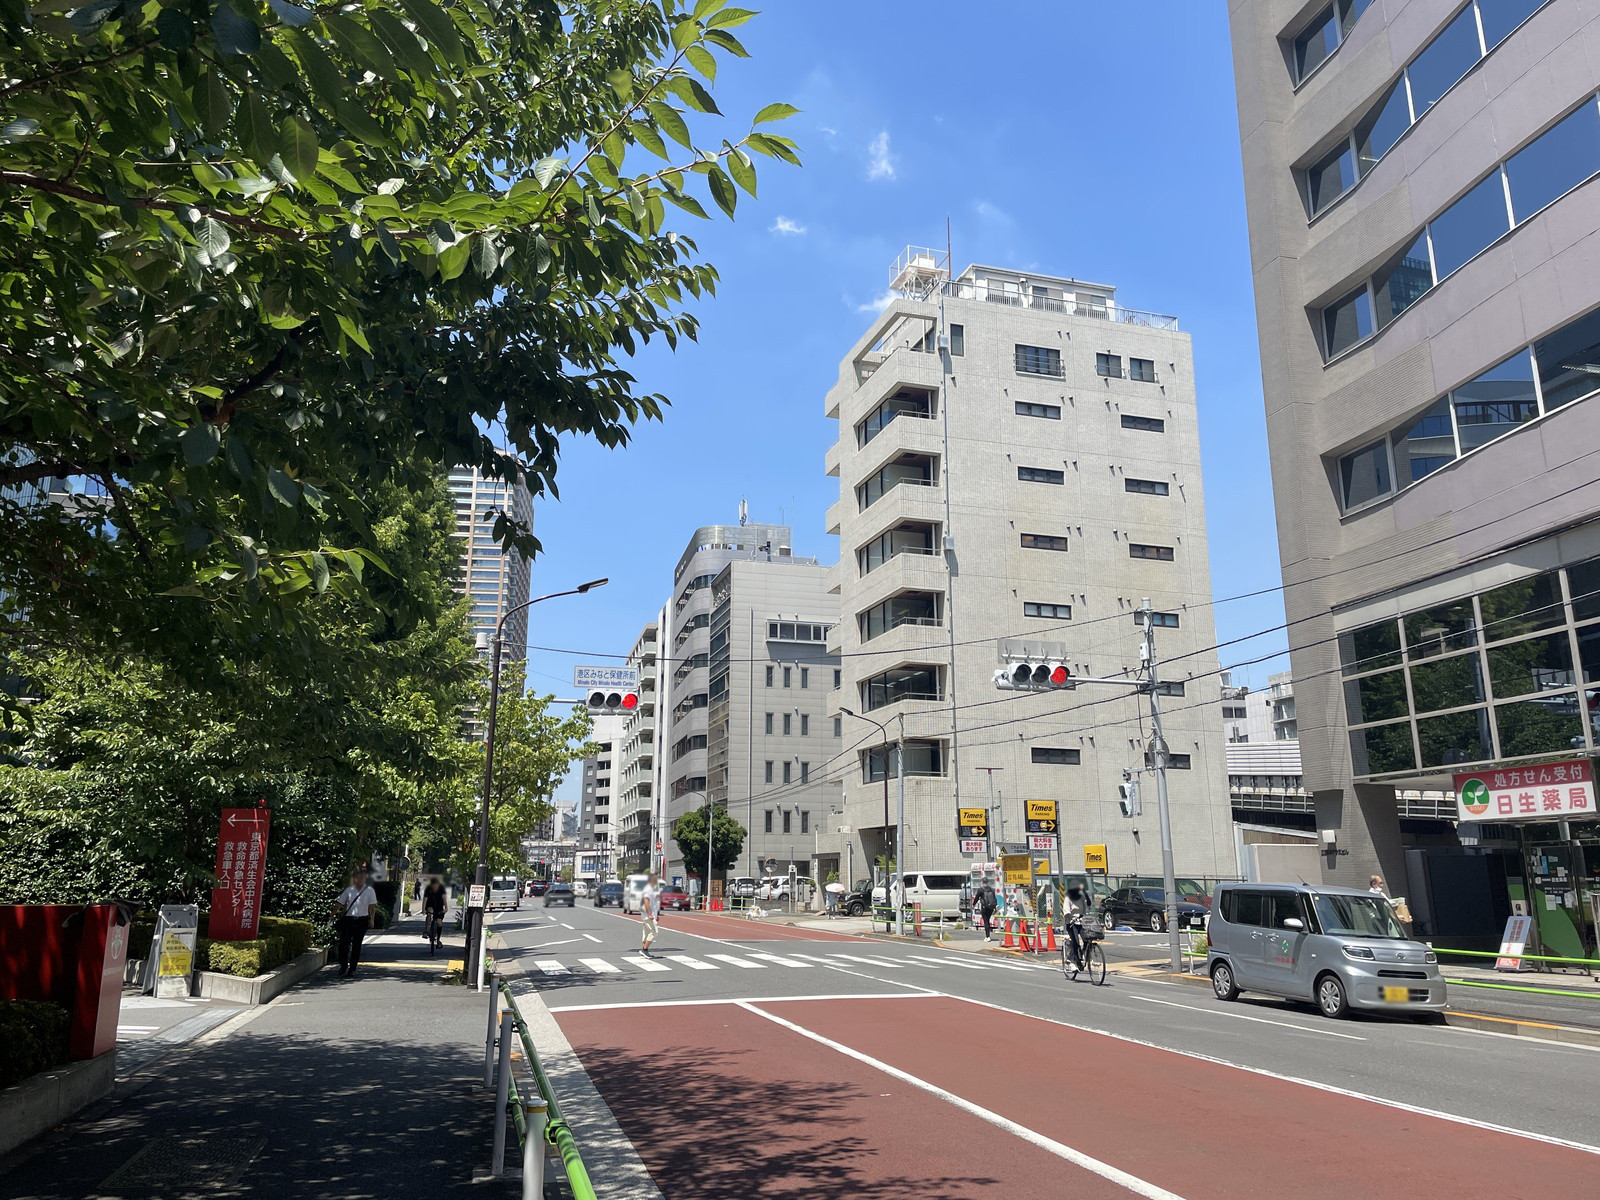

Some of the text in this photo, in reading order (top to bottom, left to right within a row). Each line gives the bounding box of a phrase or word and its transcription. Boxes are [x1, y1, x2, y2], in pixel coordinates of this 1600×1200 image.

[577, 669, 636, 681] 港区みなと保健所前
[1494, 764, 1583, 788] 処方せん受付
[1031, 803, 1053, 812] Times
[1497, 787, 1588, 815] 日生薬局
[219, 841, 235, 890] 救急車入口
[1086, 853, 1102, 862] Times
[231, 841, 248, 917] 救命救急センター
[241, 832, 261, 929] 東京都済生会中央病院
